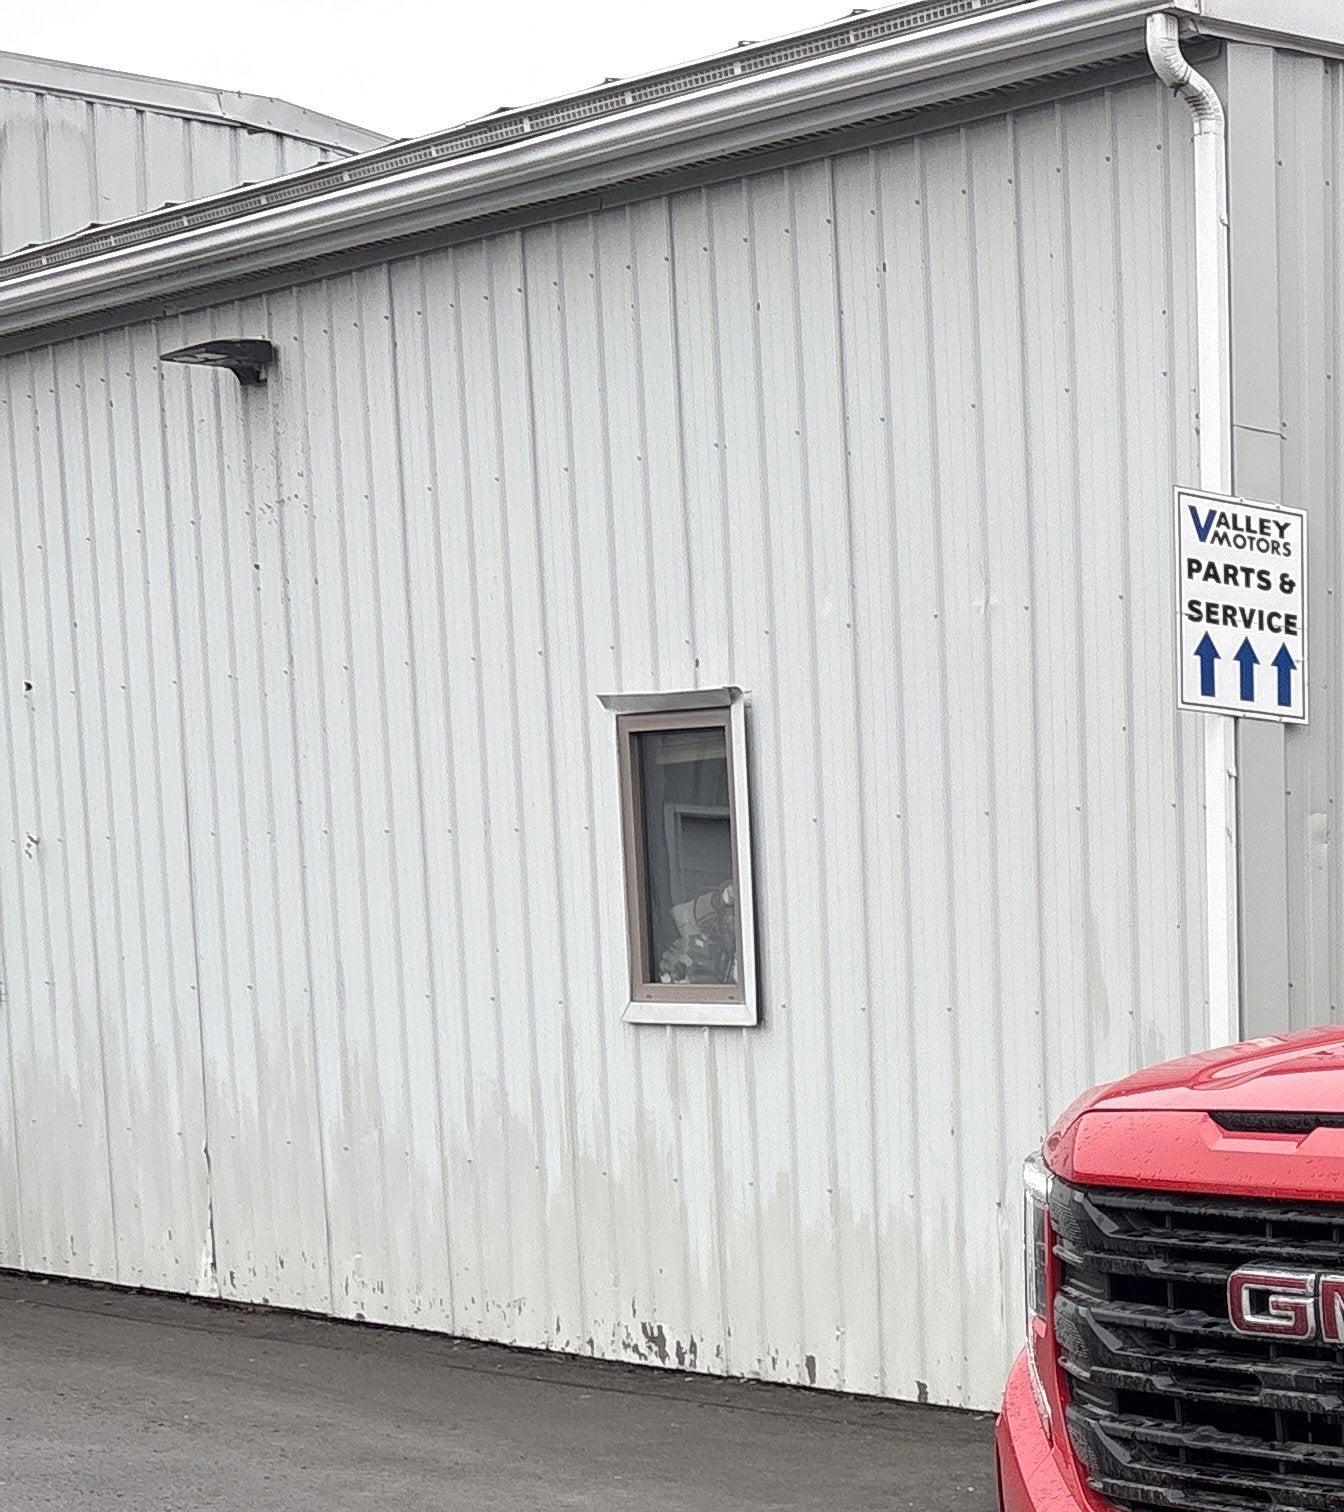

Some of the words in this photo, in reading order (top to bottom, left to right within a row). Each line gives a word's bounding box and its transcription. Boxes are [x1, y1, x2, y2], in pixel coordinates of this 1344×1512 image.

[1187, 504, 1292, 543] VALLEY
[1209, 529, 1292, 558] MOTORS
[1186, 557, 1273, 592] PARTS
[1278, 572, 1297, 595] &
[1187, 599, 1298, 637] SERVICE
